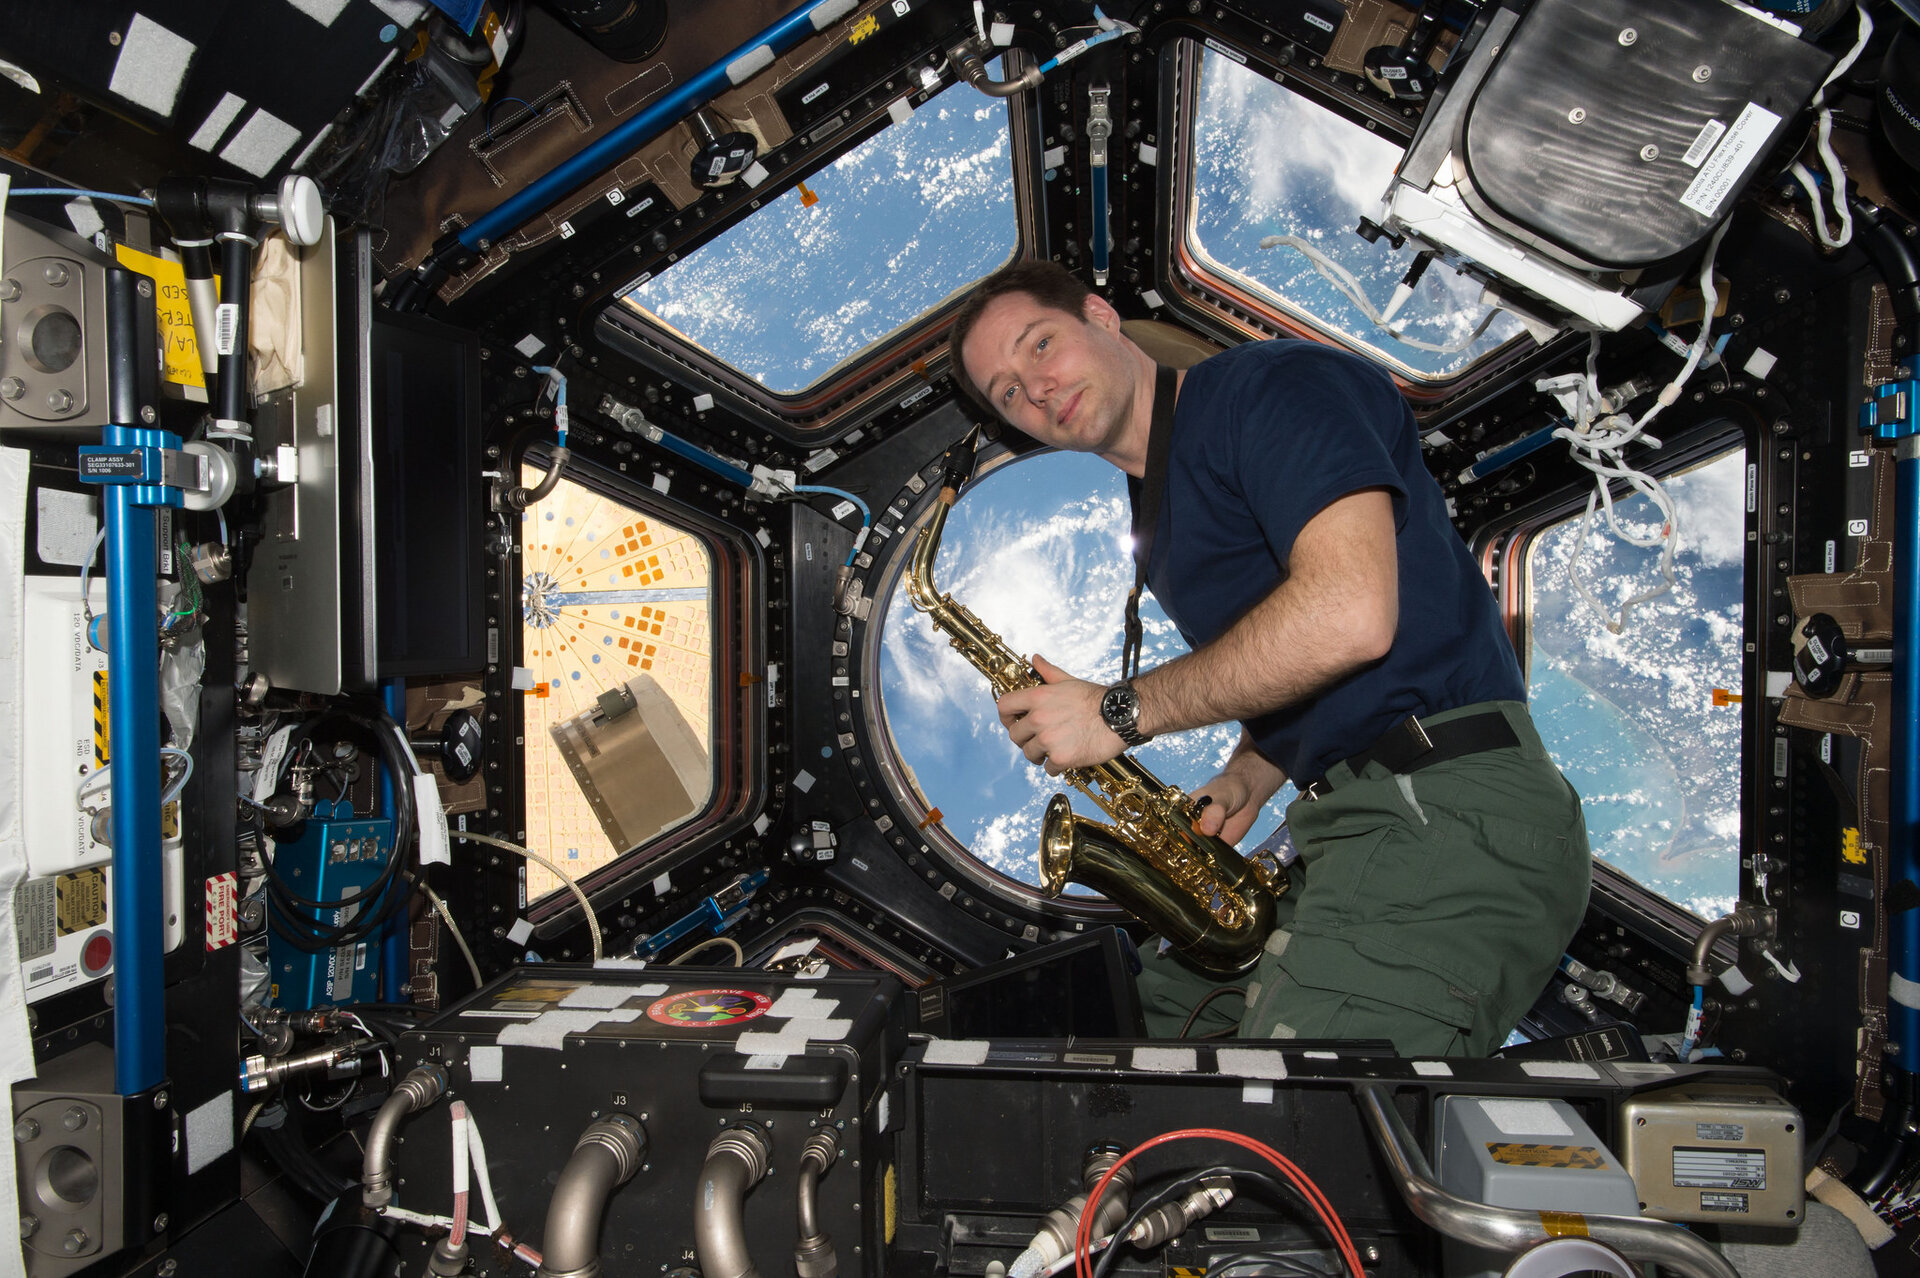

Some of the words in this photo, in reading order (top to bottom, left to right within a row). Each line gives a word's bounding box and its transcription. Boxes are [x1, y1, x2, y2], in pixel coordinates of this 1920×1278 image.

[1686, 175, 1706, 201] Cupola
[1703, 161, 1716, 178] ATU
[1736, 109, 1754, 131] Cover
[1714, 178, 1732, 198] 00001
[609, 191, 622, 204] G
[1851, 453, 1867, 464] H
[162, 515, 170, 551] Support
[1849, 521, 1866, 534] G
[73, 612, 81, 628] 120
[1812, 639, 1826, 658] CLOSED
[98, 658, 105, 669] J3
[46, 880, 54, 903] UTILITY
[333, 910, 341, 928] upply
[1841, 913, 1858, 926] C
[327, 954, 336, 979] 120VDC
[325, 980, 334, 997] A31P
[429, 1046, 441, 1057] J1
[613, 1095, 627, 1106] J3
[739, 1102, 753, 1114] J5
[819, 1107, 834, 1119] J7
[681, 1249, 695, 1262] J4
